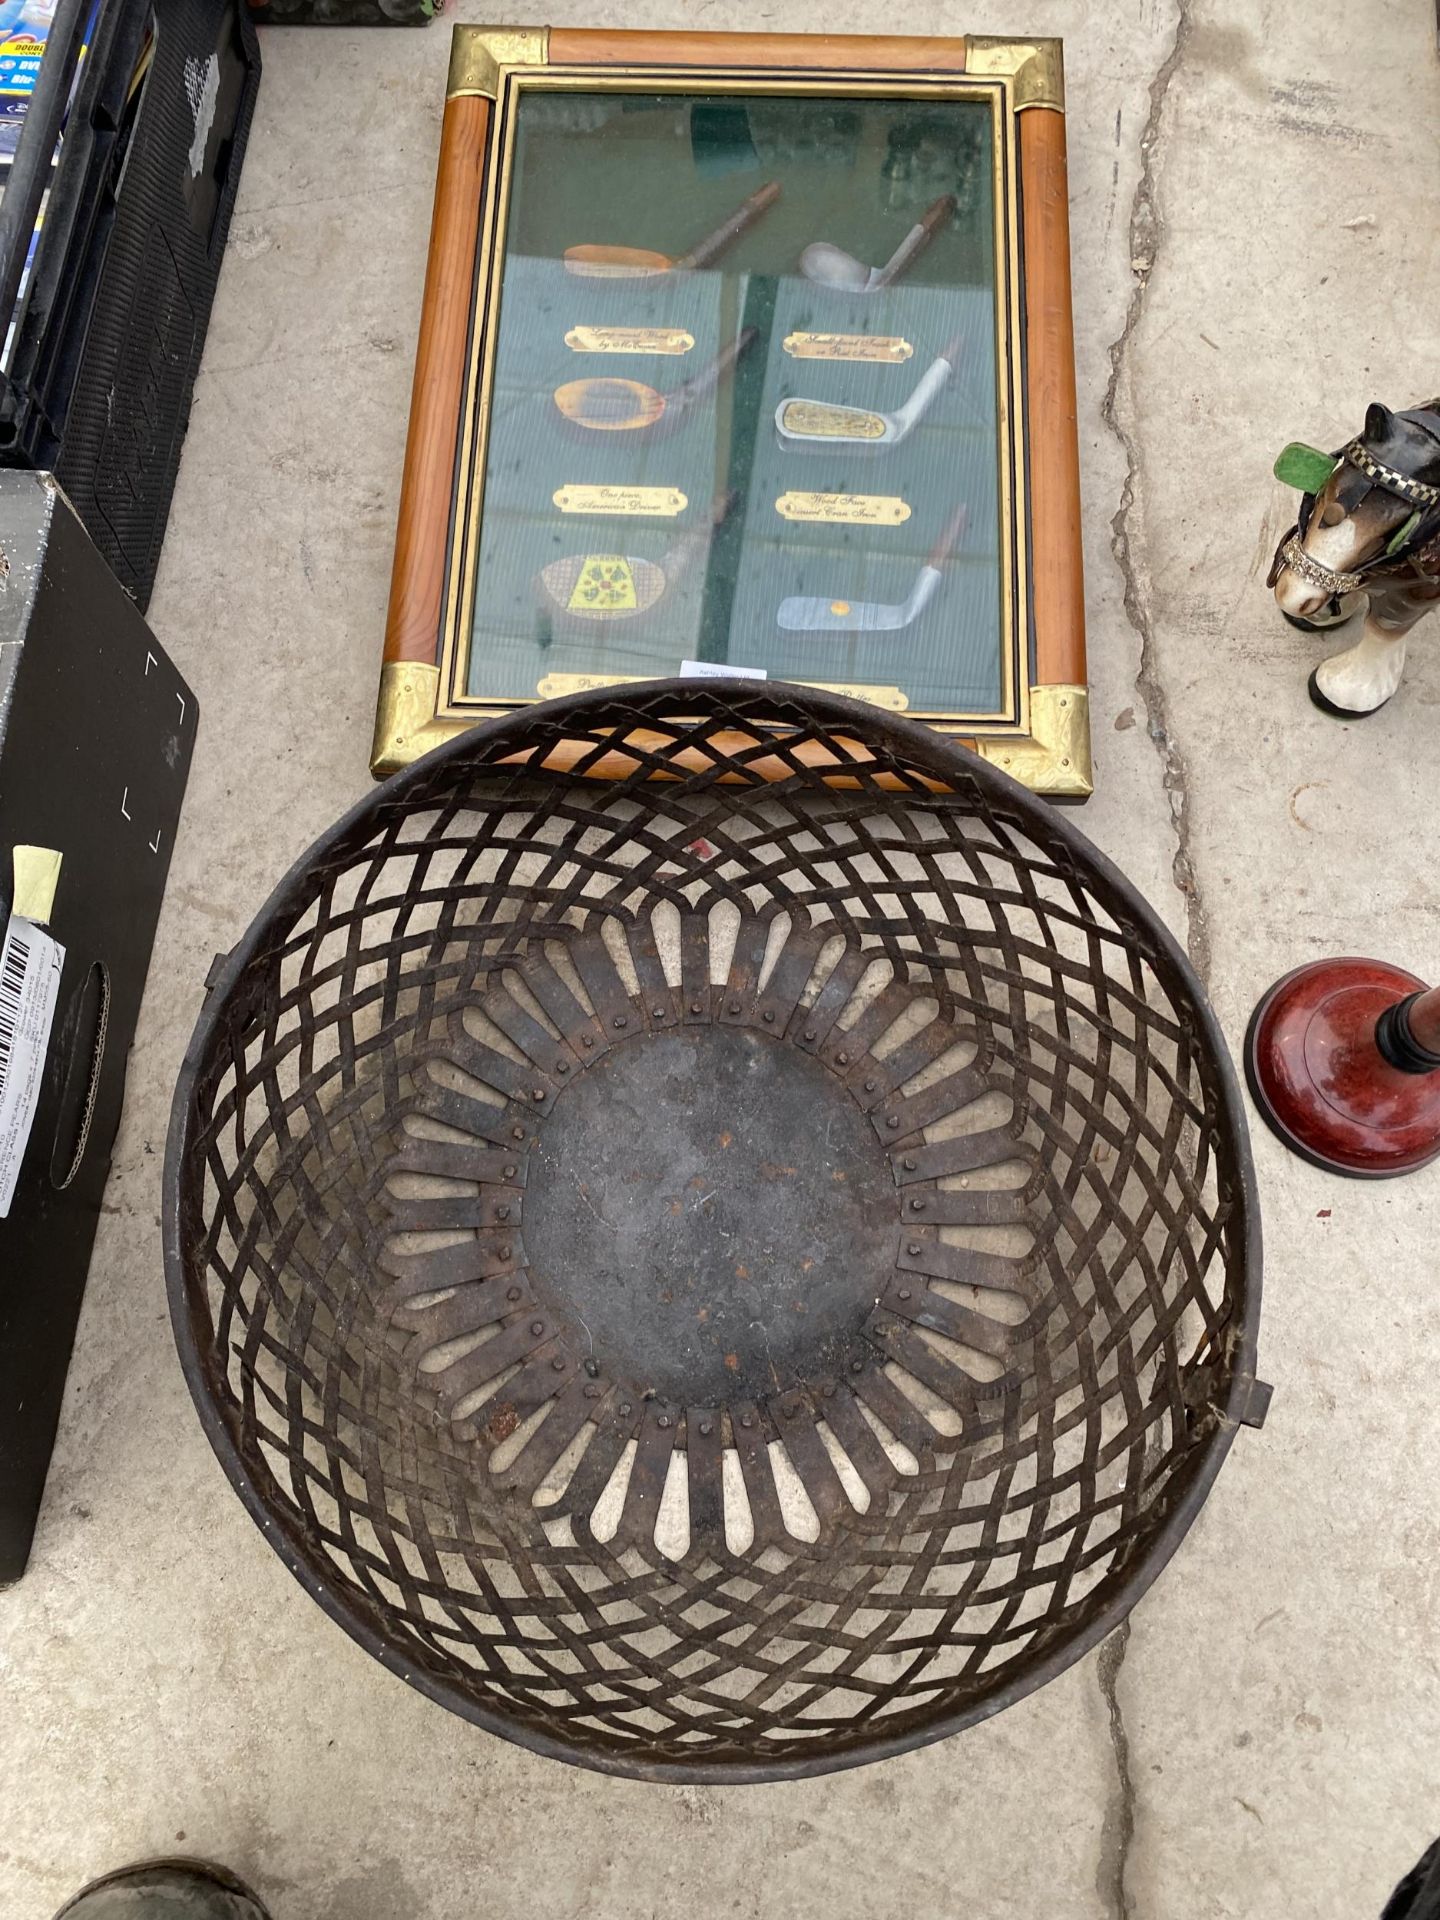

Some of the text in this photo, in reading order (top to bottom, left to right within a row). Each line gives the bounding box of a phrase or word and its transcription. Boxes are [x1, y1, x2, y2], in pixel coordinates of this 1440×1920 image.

[15, 43, 45, 51] DOUBL
[18, 60, 42, 71] DV
[599, 340, 610, 350] by
[600, 488, 618, 498] One
[577, 499, 662, 511] American Driver
